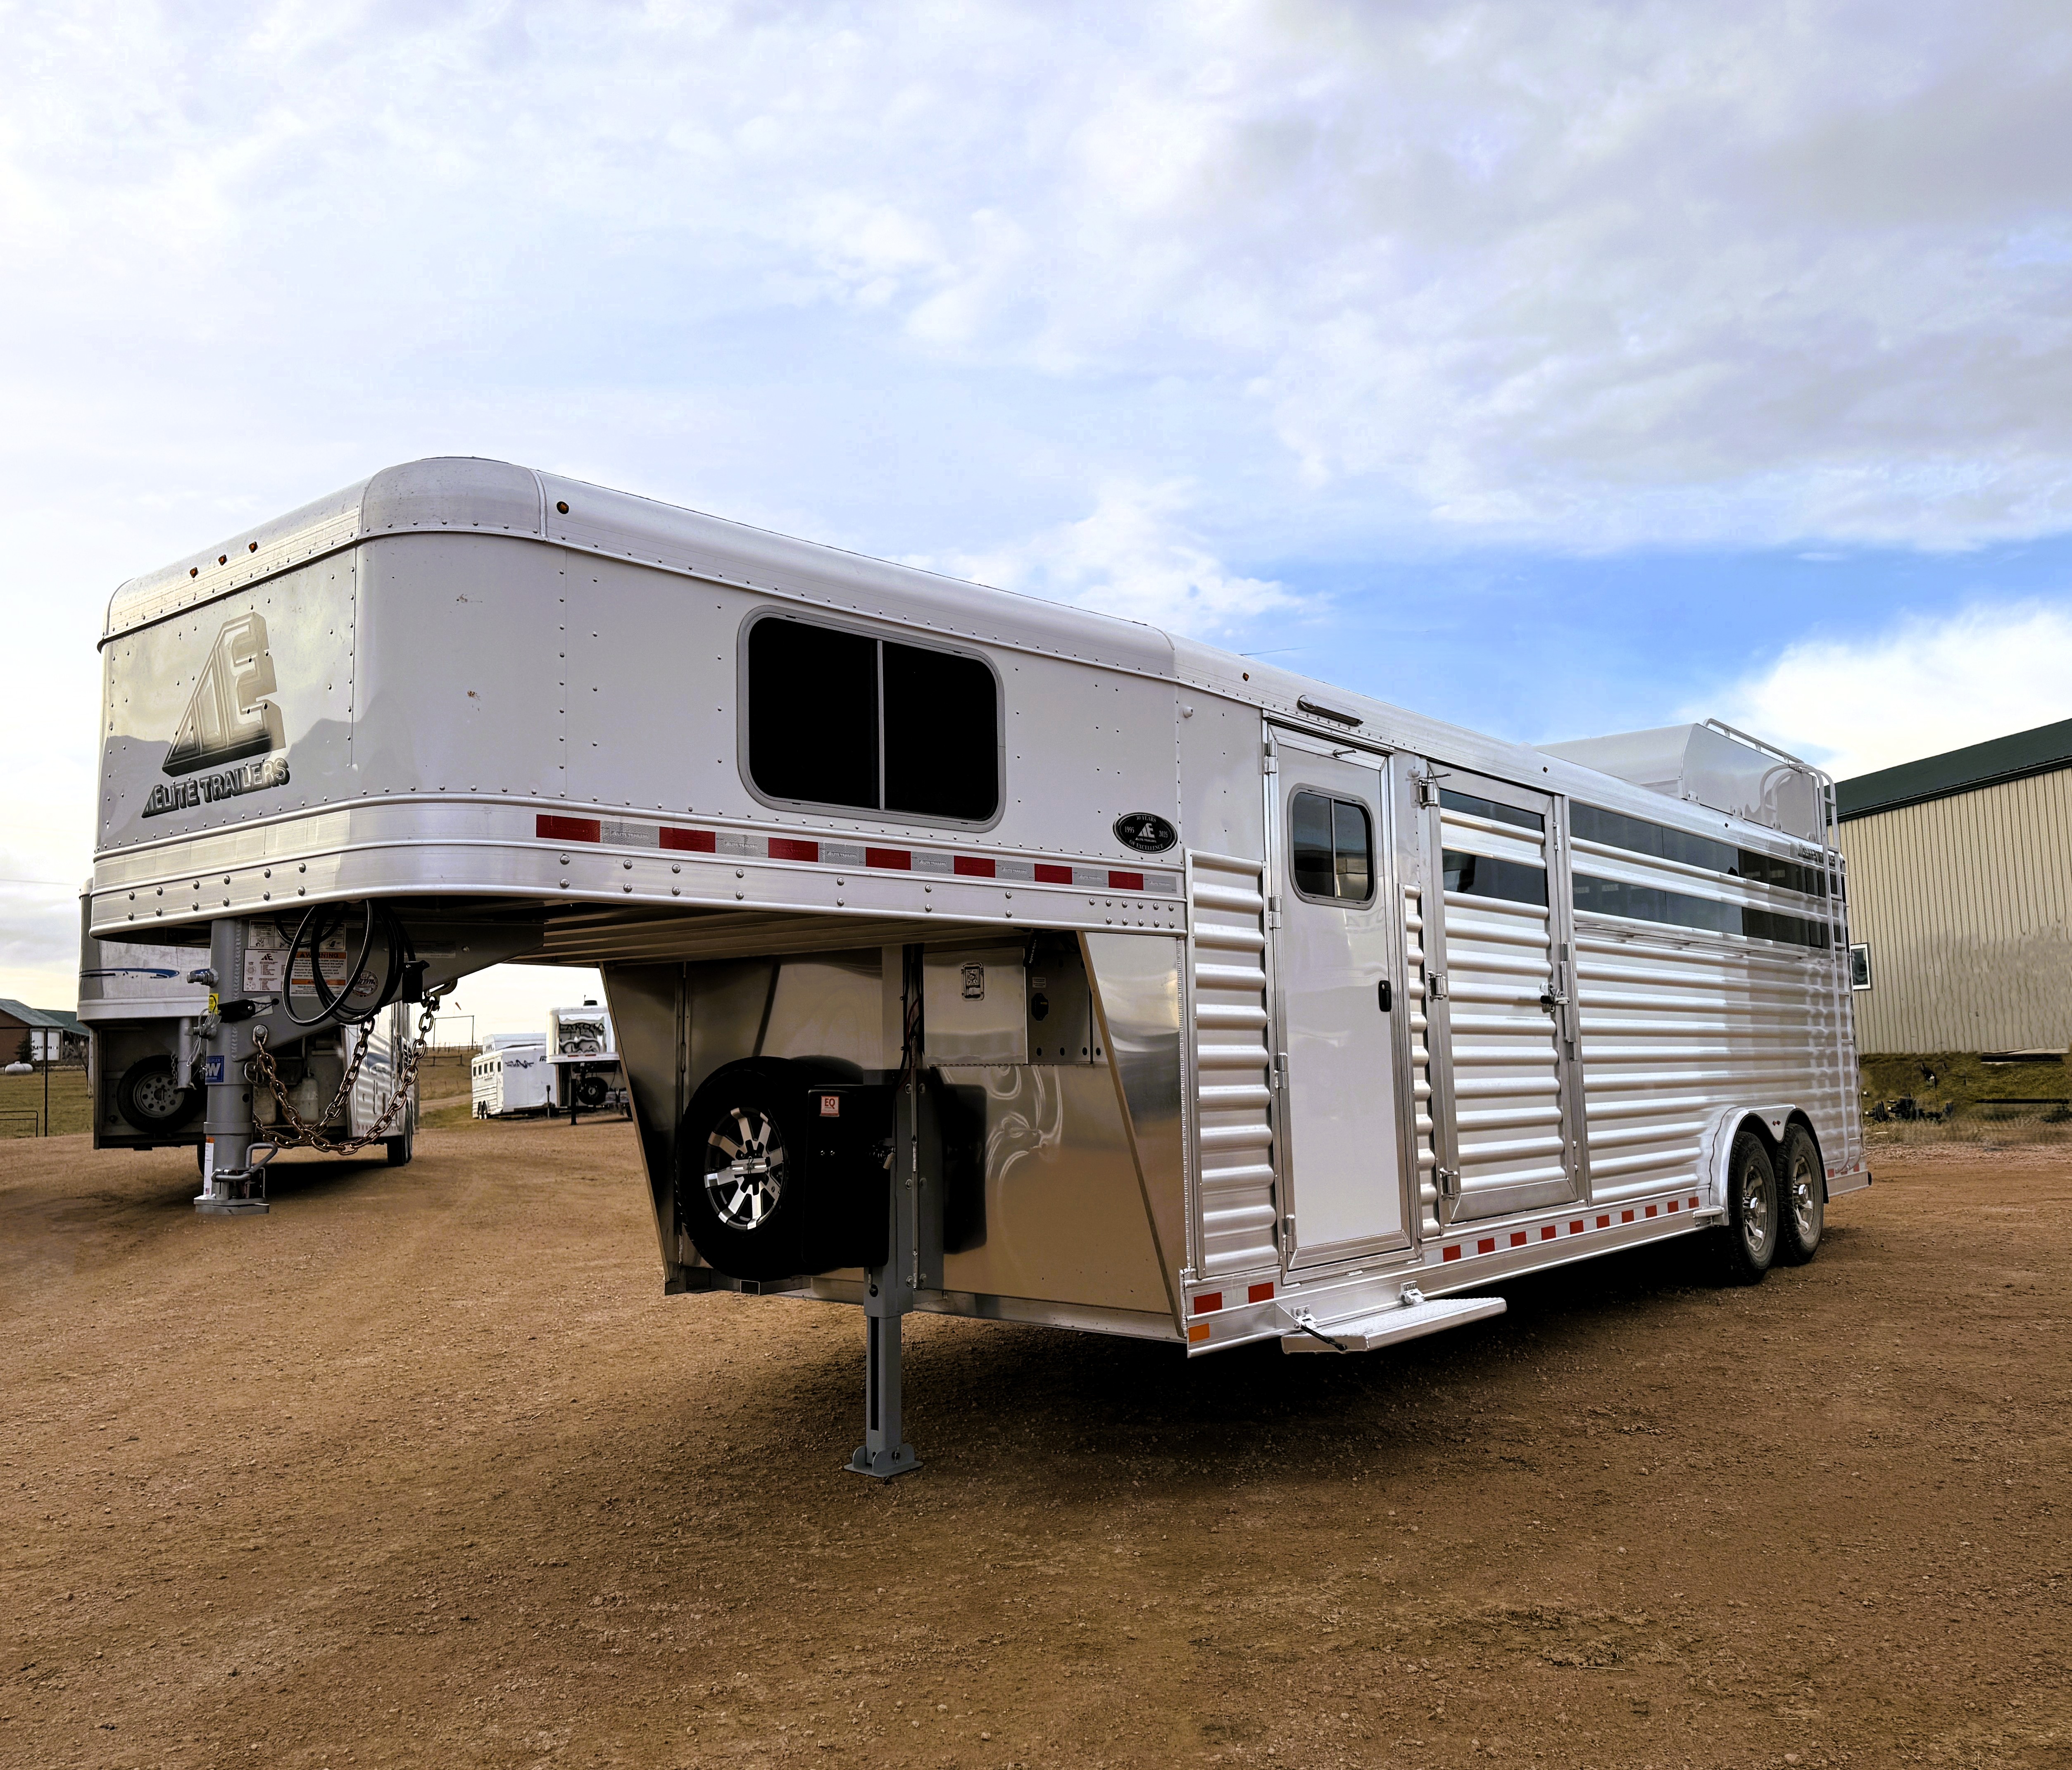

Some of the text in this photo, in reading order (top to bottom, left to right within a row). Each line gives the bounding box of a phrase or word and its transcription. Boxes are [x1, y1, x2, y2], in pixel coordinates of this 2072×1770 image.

[141, 757, 290, 818] ELITE TRAILERS
[825, 1098, 835, 1109] EQ
